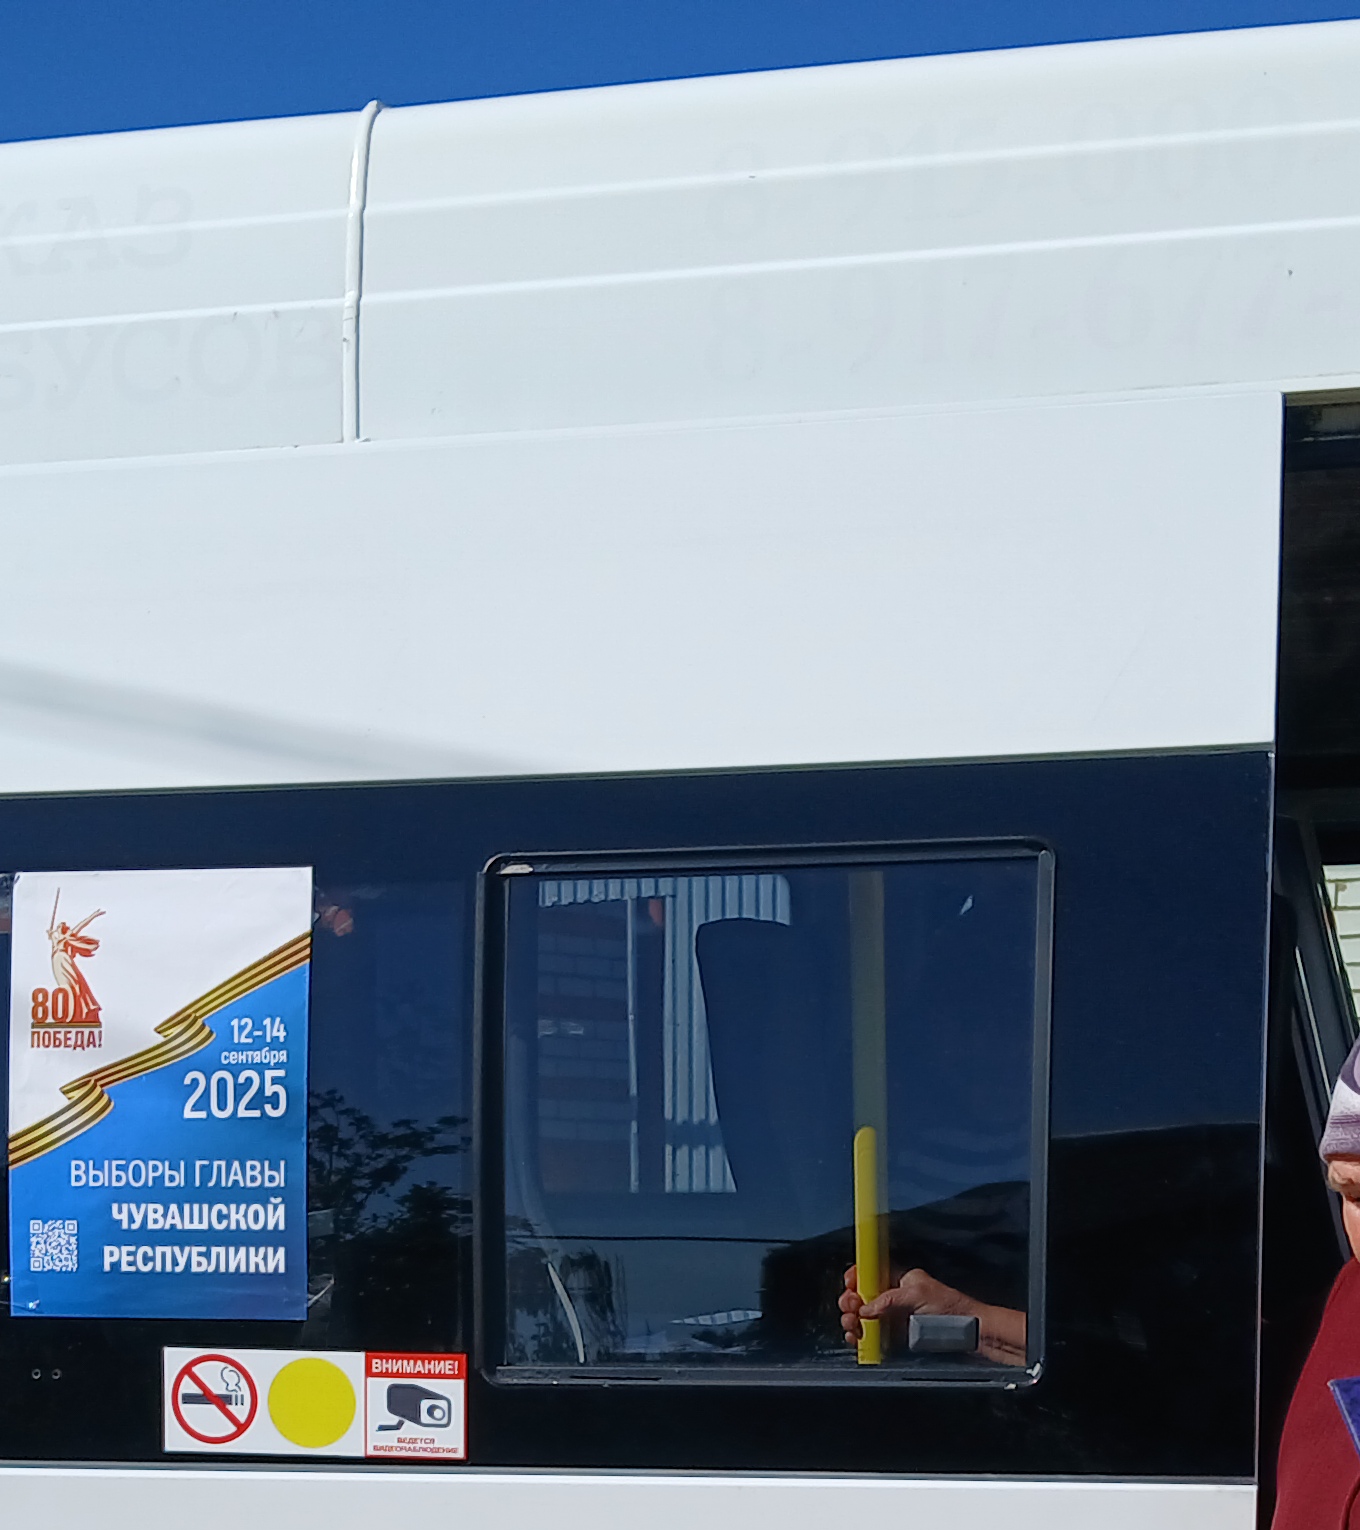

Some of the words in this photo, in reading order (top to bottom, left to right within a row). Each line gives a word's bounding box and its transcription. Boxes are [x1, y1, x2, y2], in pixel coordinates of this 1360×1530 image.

[31, 987, 70, 1024] 80
[30, 1030, 103, 1051] ПОБЕДА!
[230, 1016, 287, 1044] 12-14
[220, 1046, 288, 1066] сентября
[183, 1069, 288, 1119] 2025
[70, 1159, 185, 1188] ВЫБОРЫ
[194, 1159, 286, 1188] ГЛАВЫ
[111, 1196, 286, 1231] ЧУВАШСКОЙ
[102, 1245, 286, 1274] РЕСПУБЛИКИ
[371, 1358, 459, 1375] ВНИМАНИЕ!
